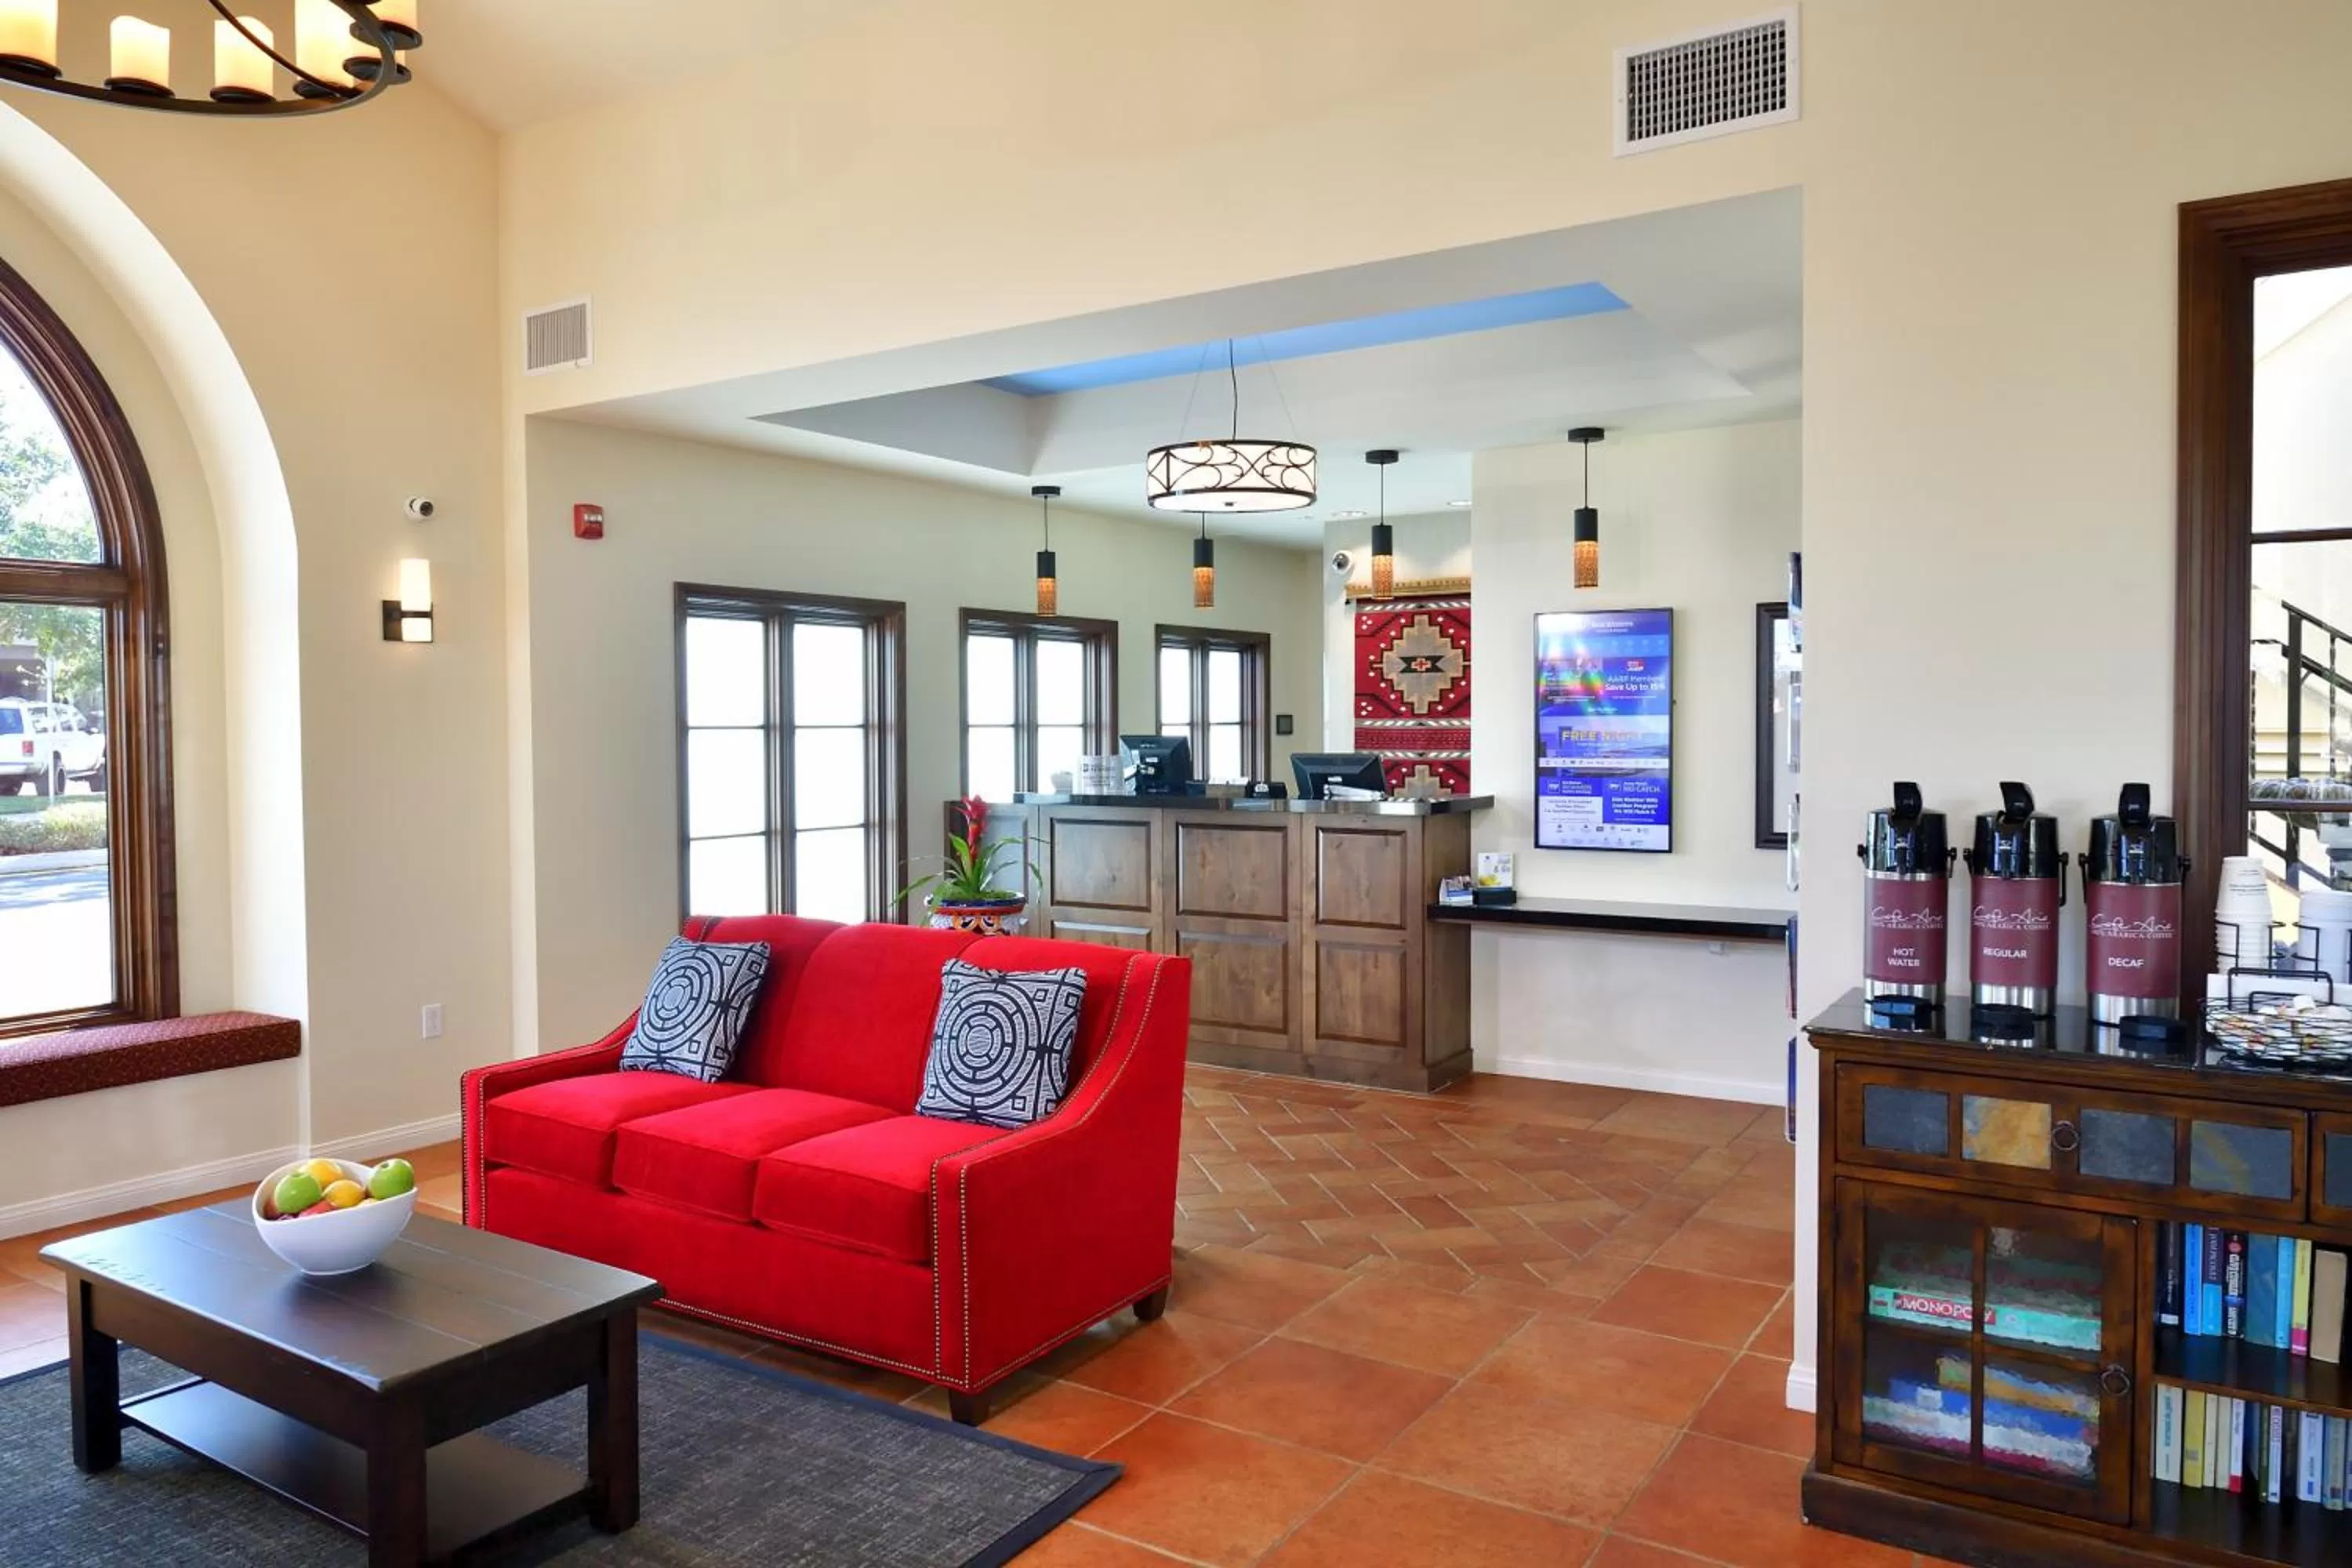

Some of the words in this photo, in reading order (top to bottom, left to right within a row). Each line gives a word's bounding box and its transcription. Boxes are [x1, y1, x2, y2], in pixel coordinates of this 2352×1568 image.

[1626, 683, 1638, 692] Up
[1563, 731, 1597, 741] FREE
[1893, 948, 1915, 956] HOT
[1983, 946, 2027, 958] REGULAR
[1887, 957, 1920, 967] WATER
[2108, 957, 2145, 967] DECAF
